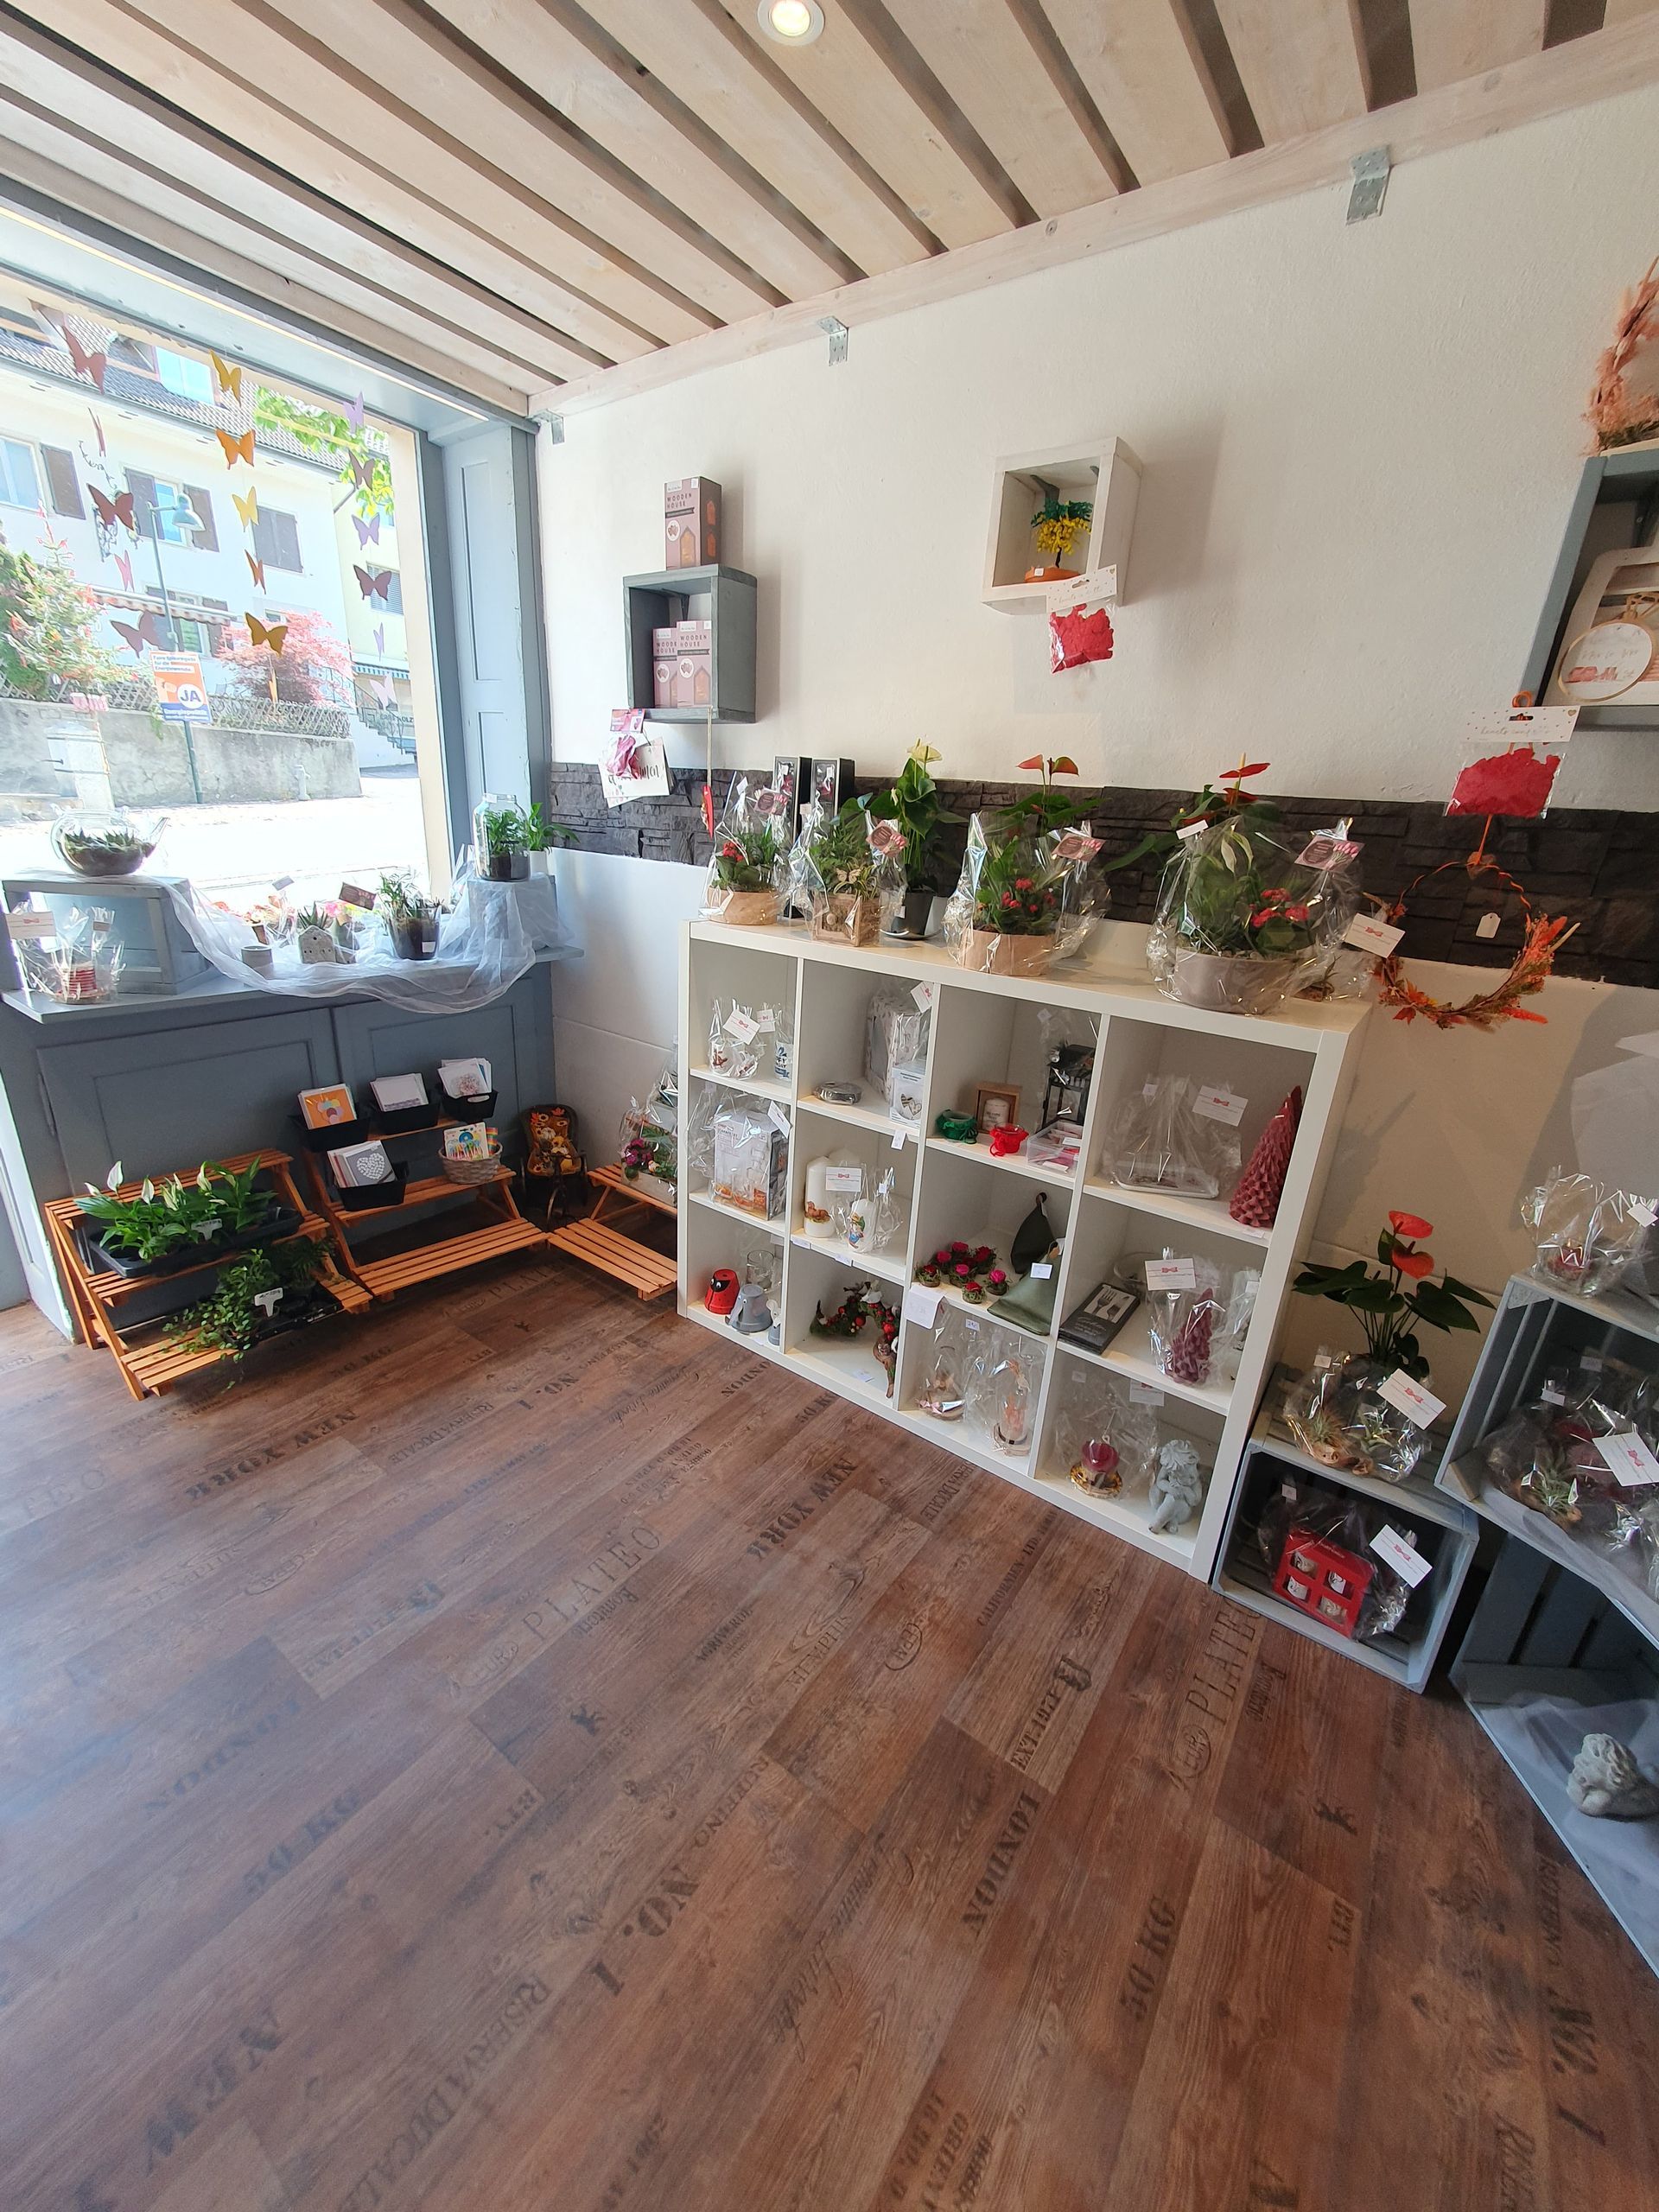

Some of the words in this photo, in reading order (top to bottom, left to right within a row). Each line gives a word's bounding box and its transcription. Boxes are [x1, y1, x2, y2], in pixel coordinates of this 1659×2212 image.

[666, 493, 692, 502] WOODEN
[180, 690, 201, 702] JA
[721, 1359, 772, 1398] ONDON
[295, 1405, 361, 1449] NEW
[184, 1446, 287, 1500] YORK
[809, 1457, 859, 1503] NEW
[745, 1500, 816, 1560] YORK
[522, 1527, 660, 1642] PLATEO
[961, 1790, 1041, 1938] LONDON
[622, 1864, 700, 1937] NO.
[589, 1961, 625, 1998] 1
[143, 2005, 290, 2178] NEW
